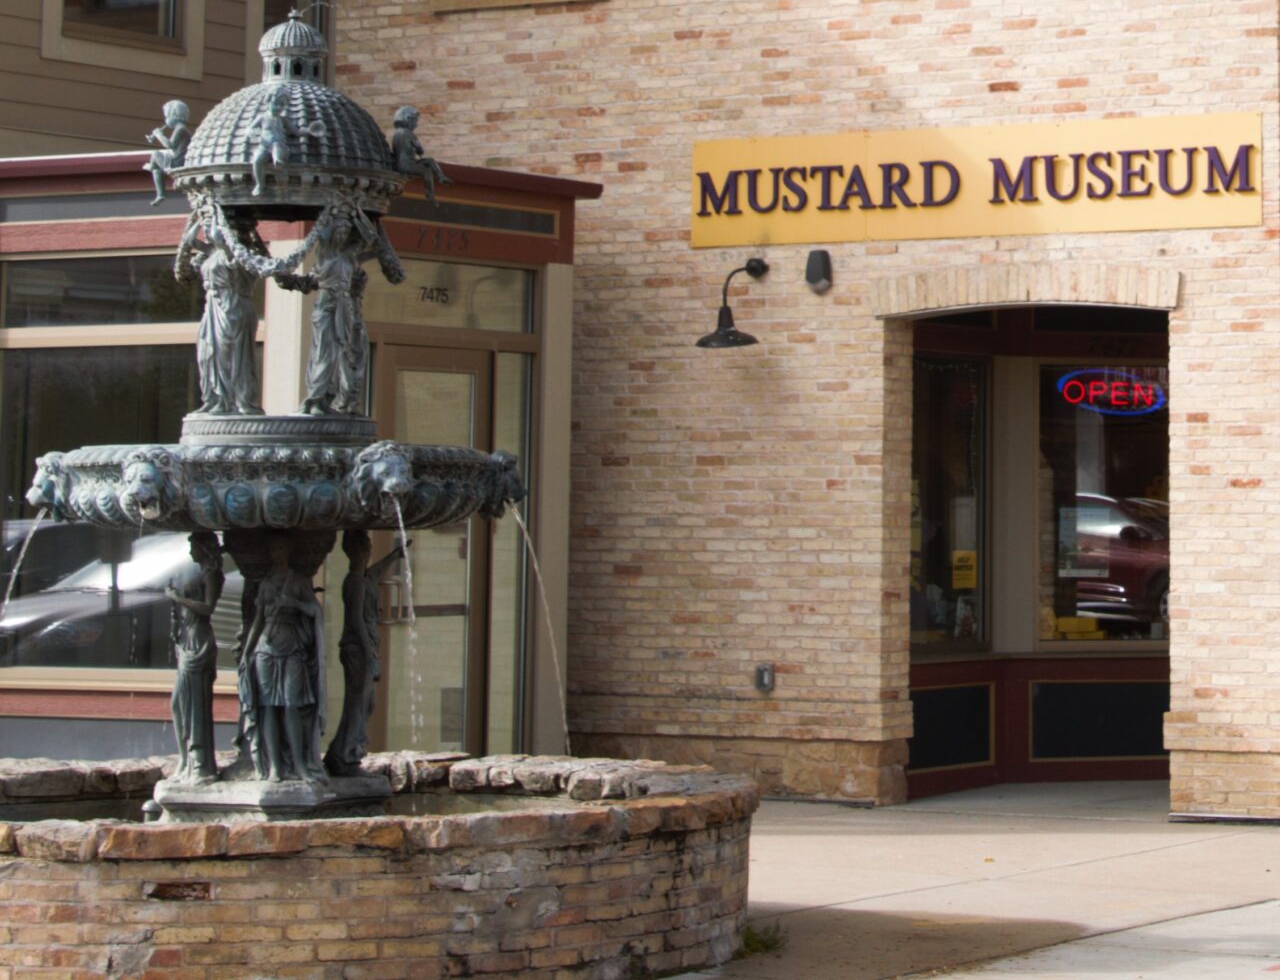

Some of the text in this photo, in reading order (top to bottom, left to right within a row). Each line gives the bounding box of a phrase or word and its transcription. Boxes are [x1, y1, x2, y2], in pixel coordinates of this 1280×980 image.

[696, 143, 1256, 217] MUSTARD MUSEUM
[420, 286, 449, 304] 7475
[1063, 380, 1153, 407] OPEN
